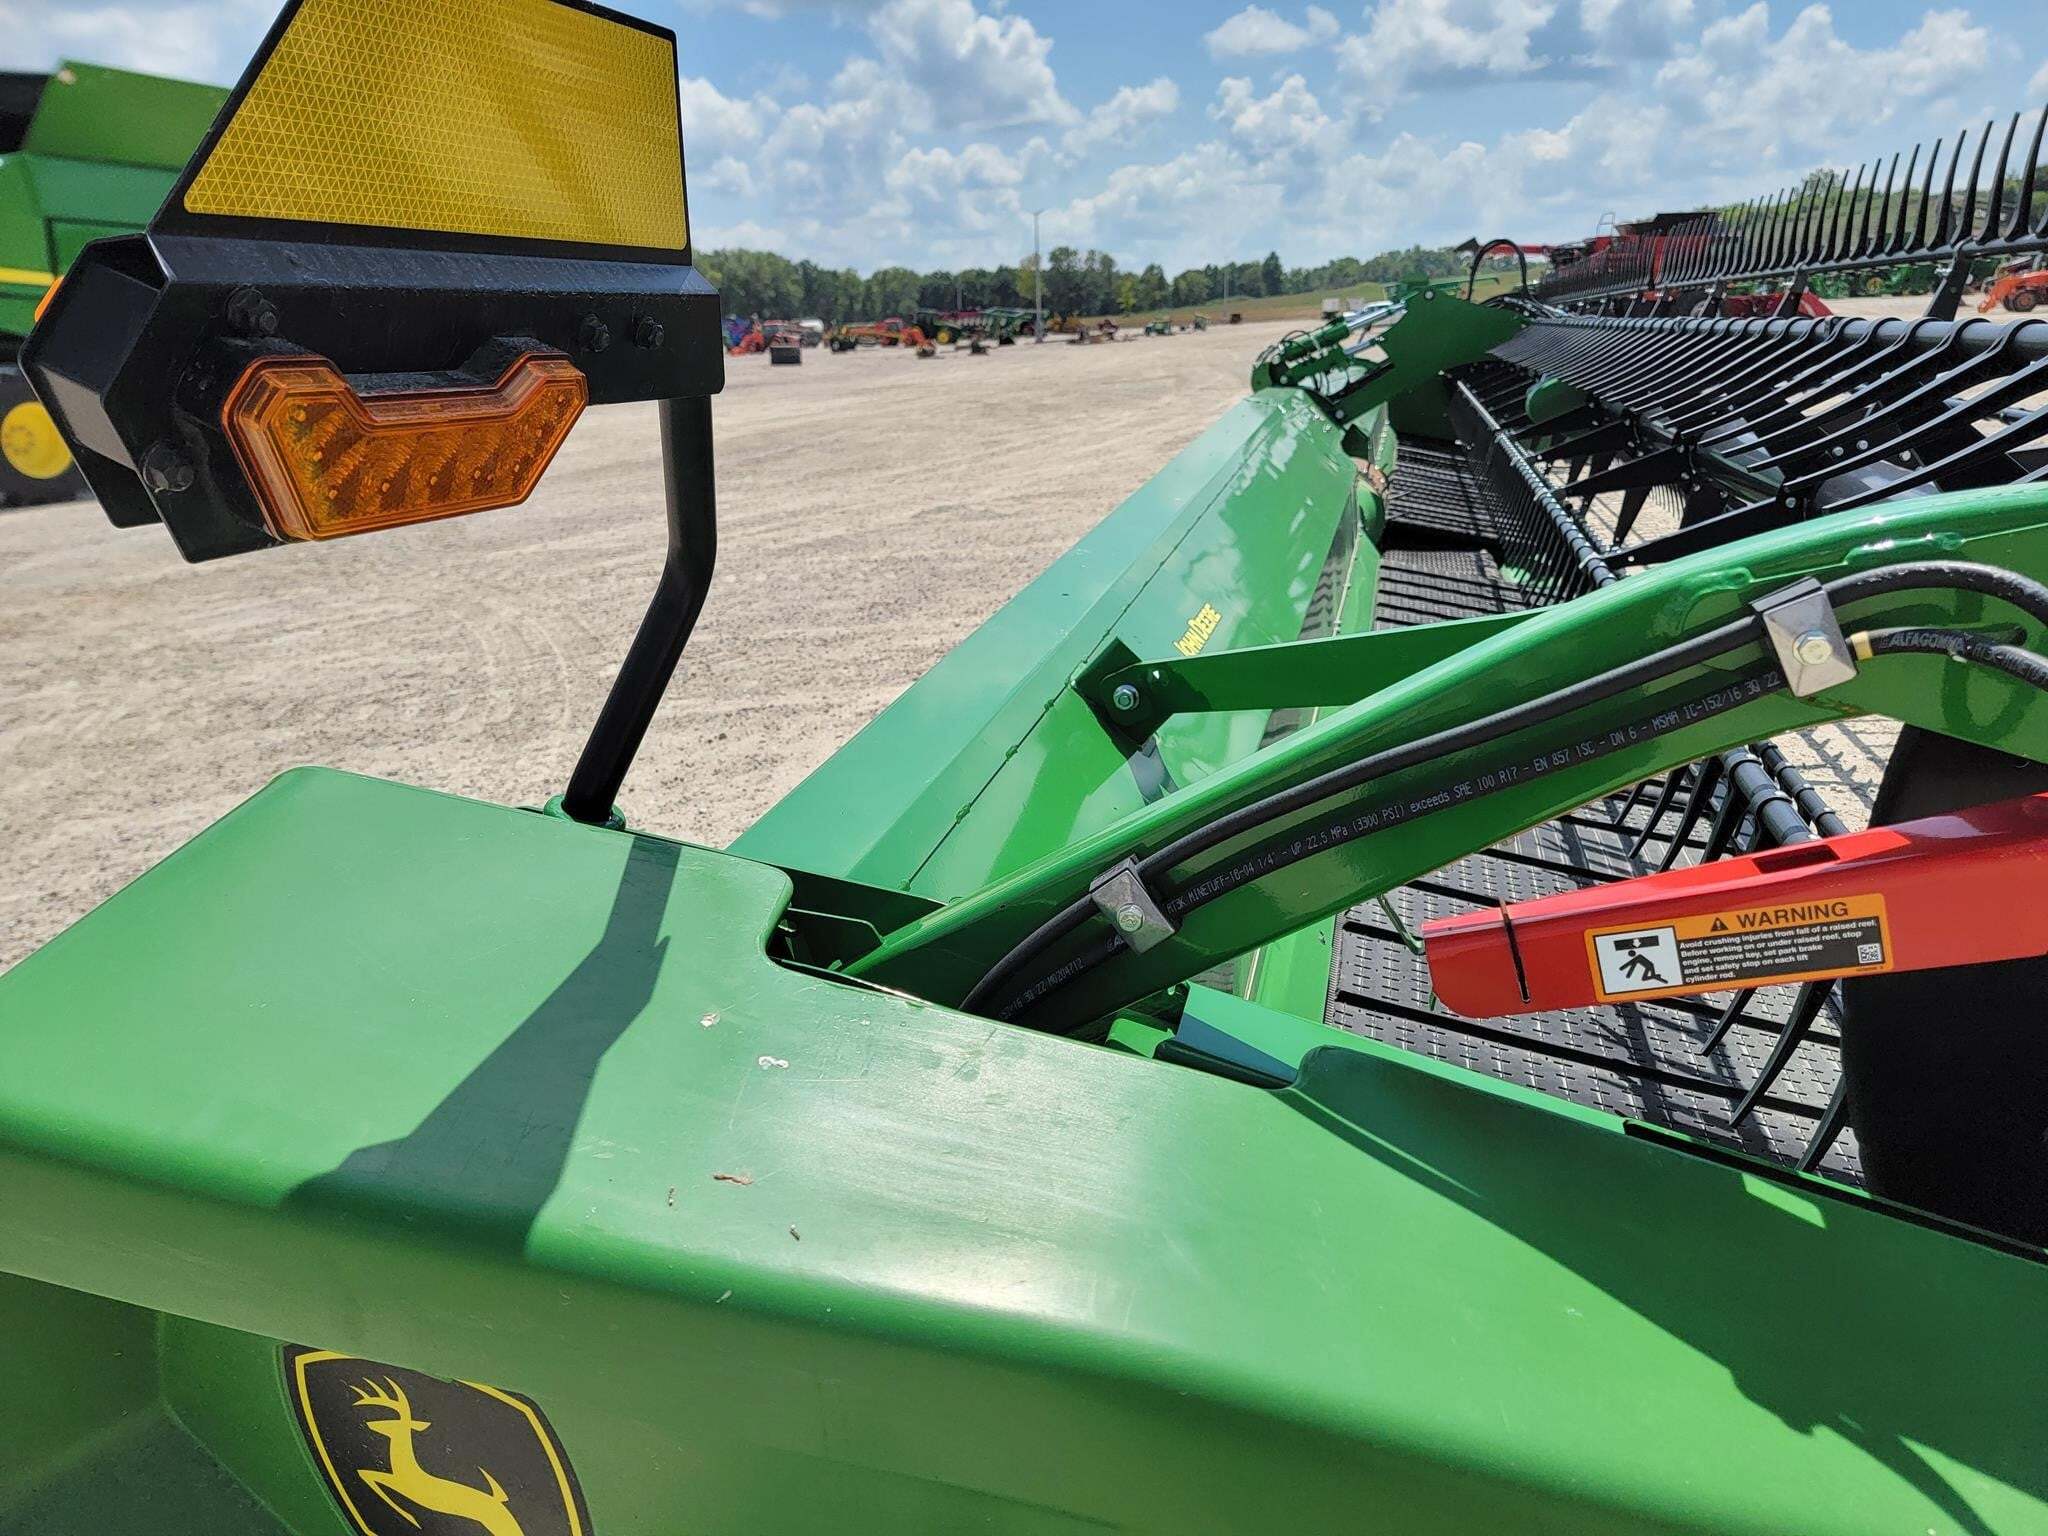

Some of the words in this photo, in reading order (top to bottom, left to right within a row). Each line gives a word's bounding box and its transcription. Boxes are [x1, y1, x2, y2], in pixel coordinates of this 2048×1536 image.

[1306, 832, 1328, 850] 22.5
[1330, 825, 1349, 841] MPa
[1352, 814, 1379, 833] (3300
[1382, 805, 1404, 821] PSI)
[1410, 791, 1450, 813] exceeds
[1453, 781, 1473, 799] SAE
[1477, 774, 1495, 791] 100
[1498, 766, 1518, 784] R17
[1533, 756, 1549, 772] EN
[1551, 748, 1569, 766] 857
[1609, 730, 1625, 746] DN
[1628, 726, 1637, 740] 6
[1763, 671, 1780, 687] 22
[1736, 902, 1848, 928] WARNING
[1680, 940, 1703, 949] Avoid
[1704, 936, 1741, 946] crushing
[1742, 932, 1774, 942] injuries
[1775, 930, 1794, 938] from
[1796, 927, 1810, 935] fall
[1829, 922, 1856, 931] raised
[1681, 949, 1708, 957] Before
[1709, 945, 1742, 954] working
[1767, 938, 1792, 947] under
[1794, 935, 1820, 944] raised
[1842, 931, 1862, 939] stop
[1682, 957, 1712, 967] engine,
[1714, 953, 1744, 962] remove
[1745, 951, 1762, 960] key,
[1763, 949, 1776, 957] set
[1778, 947, 1797, 956] park
[1798, 944, 1823, 953] brake
[1684, 966, 1699, 974] and
[1701, 964, 1714, 972] set
[1715, 962, 1740, 971] safety
[1741, 960, 1760, 968] stop
[1762, 958, 1773, 966] on
[1774, 955, 1795, 964] each
[1796, 953, 1809, 961] lift
[1685, 973, 1717, 984] cylinder
[1719, 971, 1736, 979] rod.
